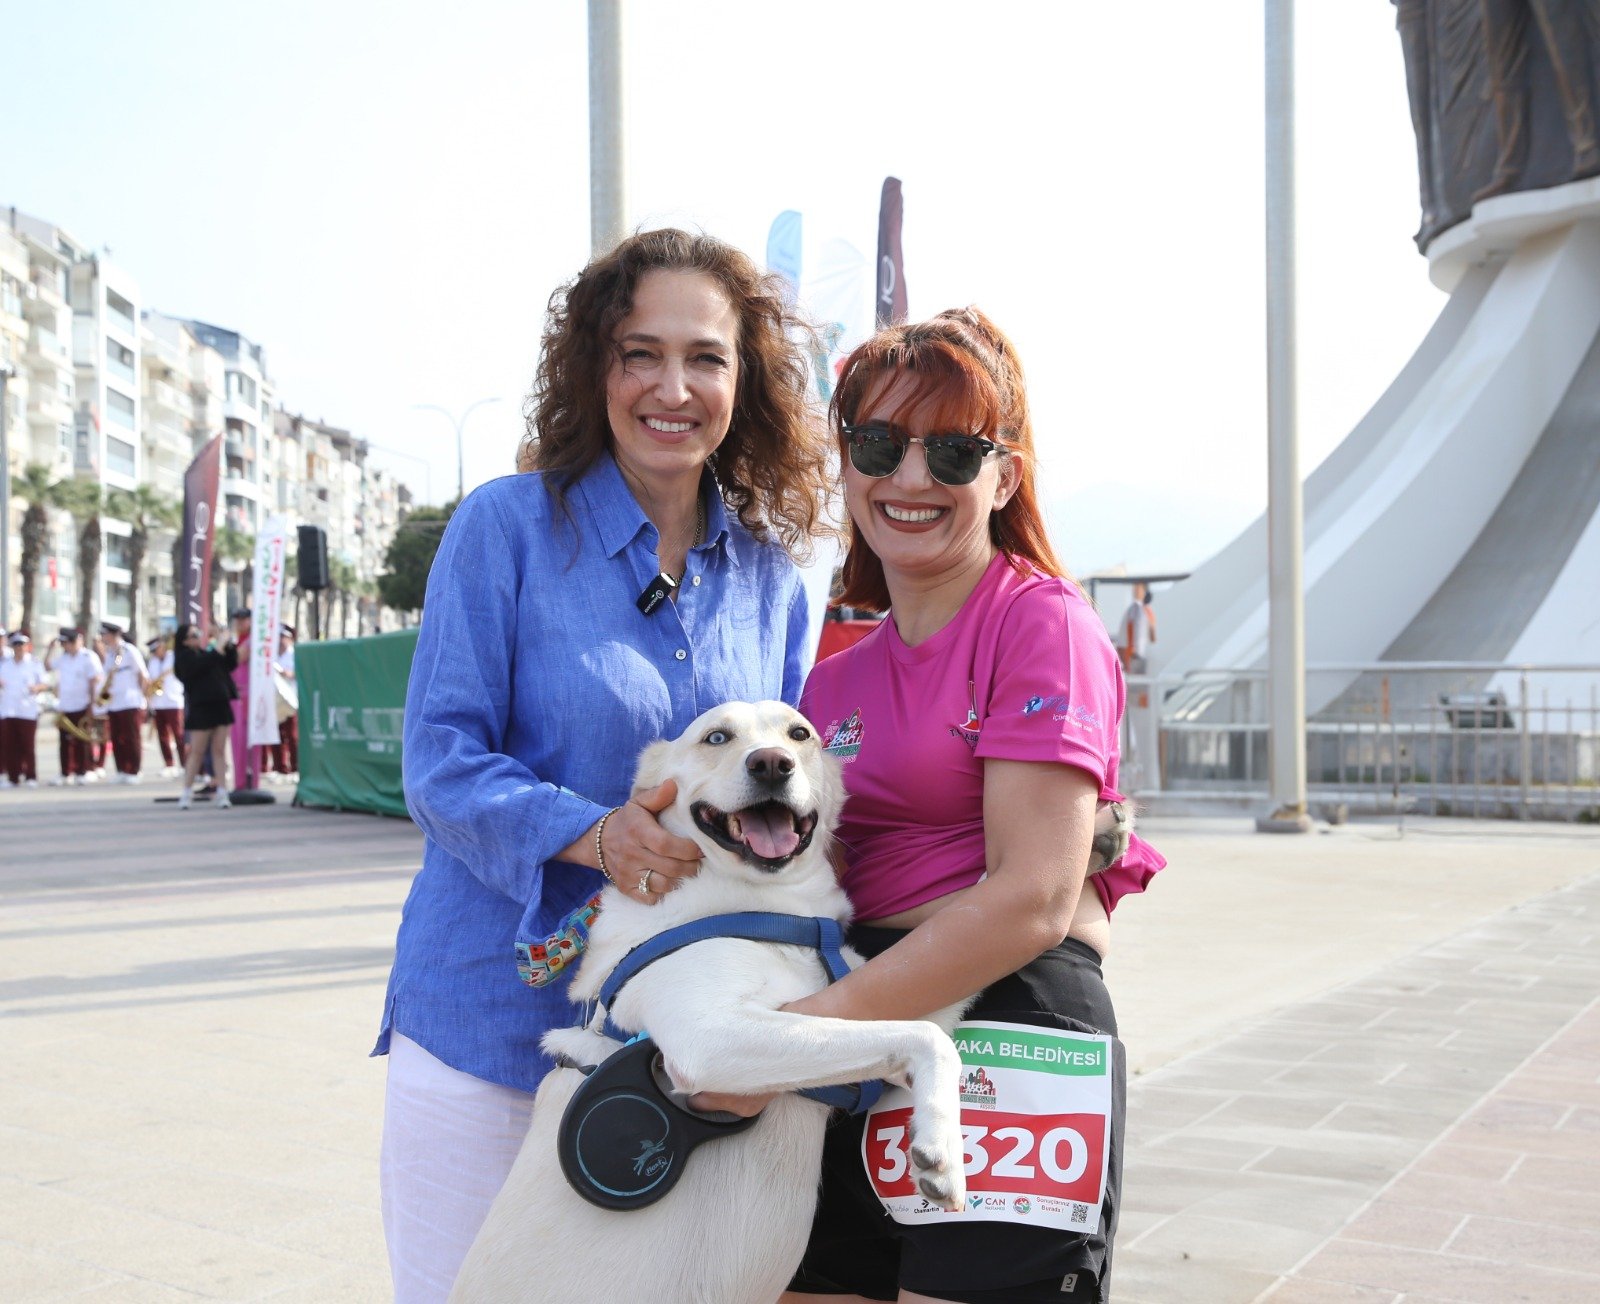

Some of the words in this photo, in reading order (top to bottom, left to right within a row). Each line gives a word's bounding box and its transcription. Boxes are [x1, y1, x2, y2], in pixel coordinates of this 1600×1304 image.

[954, 1038, 995, 1056] AKA
[999, 1042, 1101, 1066] BELEDİYESİ
[876, 1125, 1088, 1184] 3320
[985, 1197, 1006, 1206] CAN
